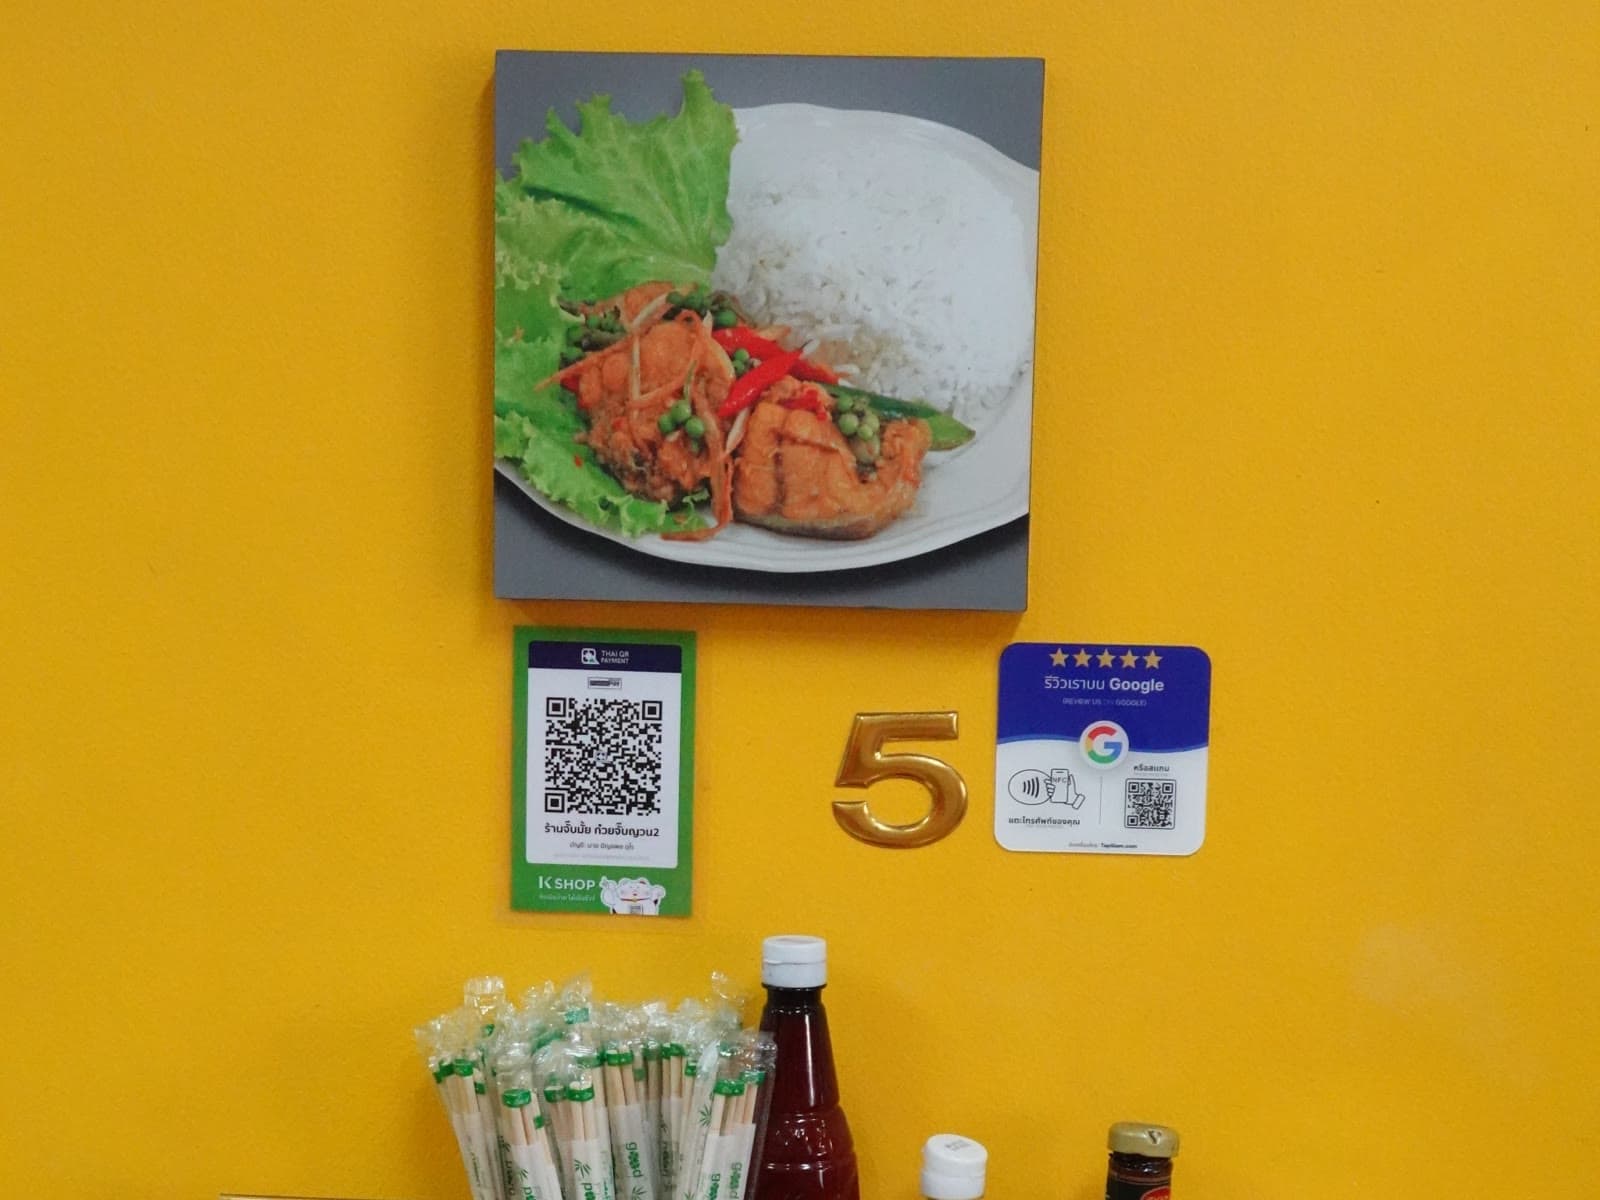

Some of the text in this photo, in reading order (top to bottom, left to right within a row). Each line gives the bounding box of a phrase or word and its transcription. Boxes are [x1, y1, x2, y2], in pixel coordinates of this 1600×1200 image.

[1044, 675, 1165, 694] รีวิวเราบน Google
[1085, 725, 1123, 764] G
[831, 710, 969, 850] 5
[538, 875, 596, 891] K SHOP
